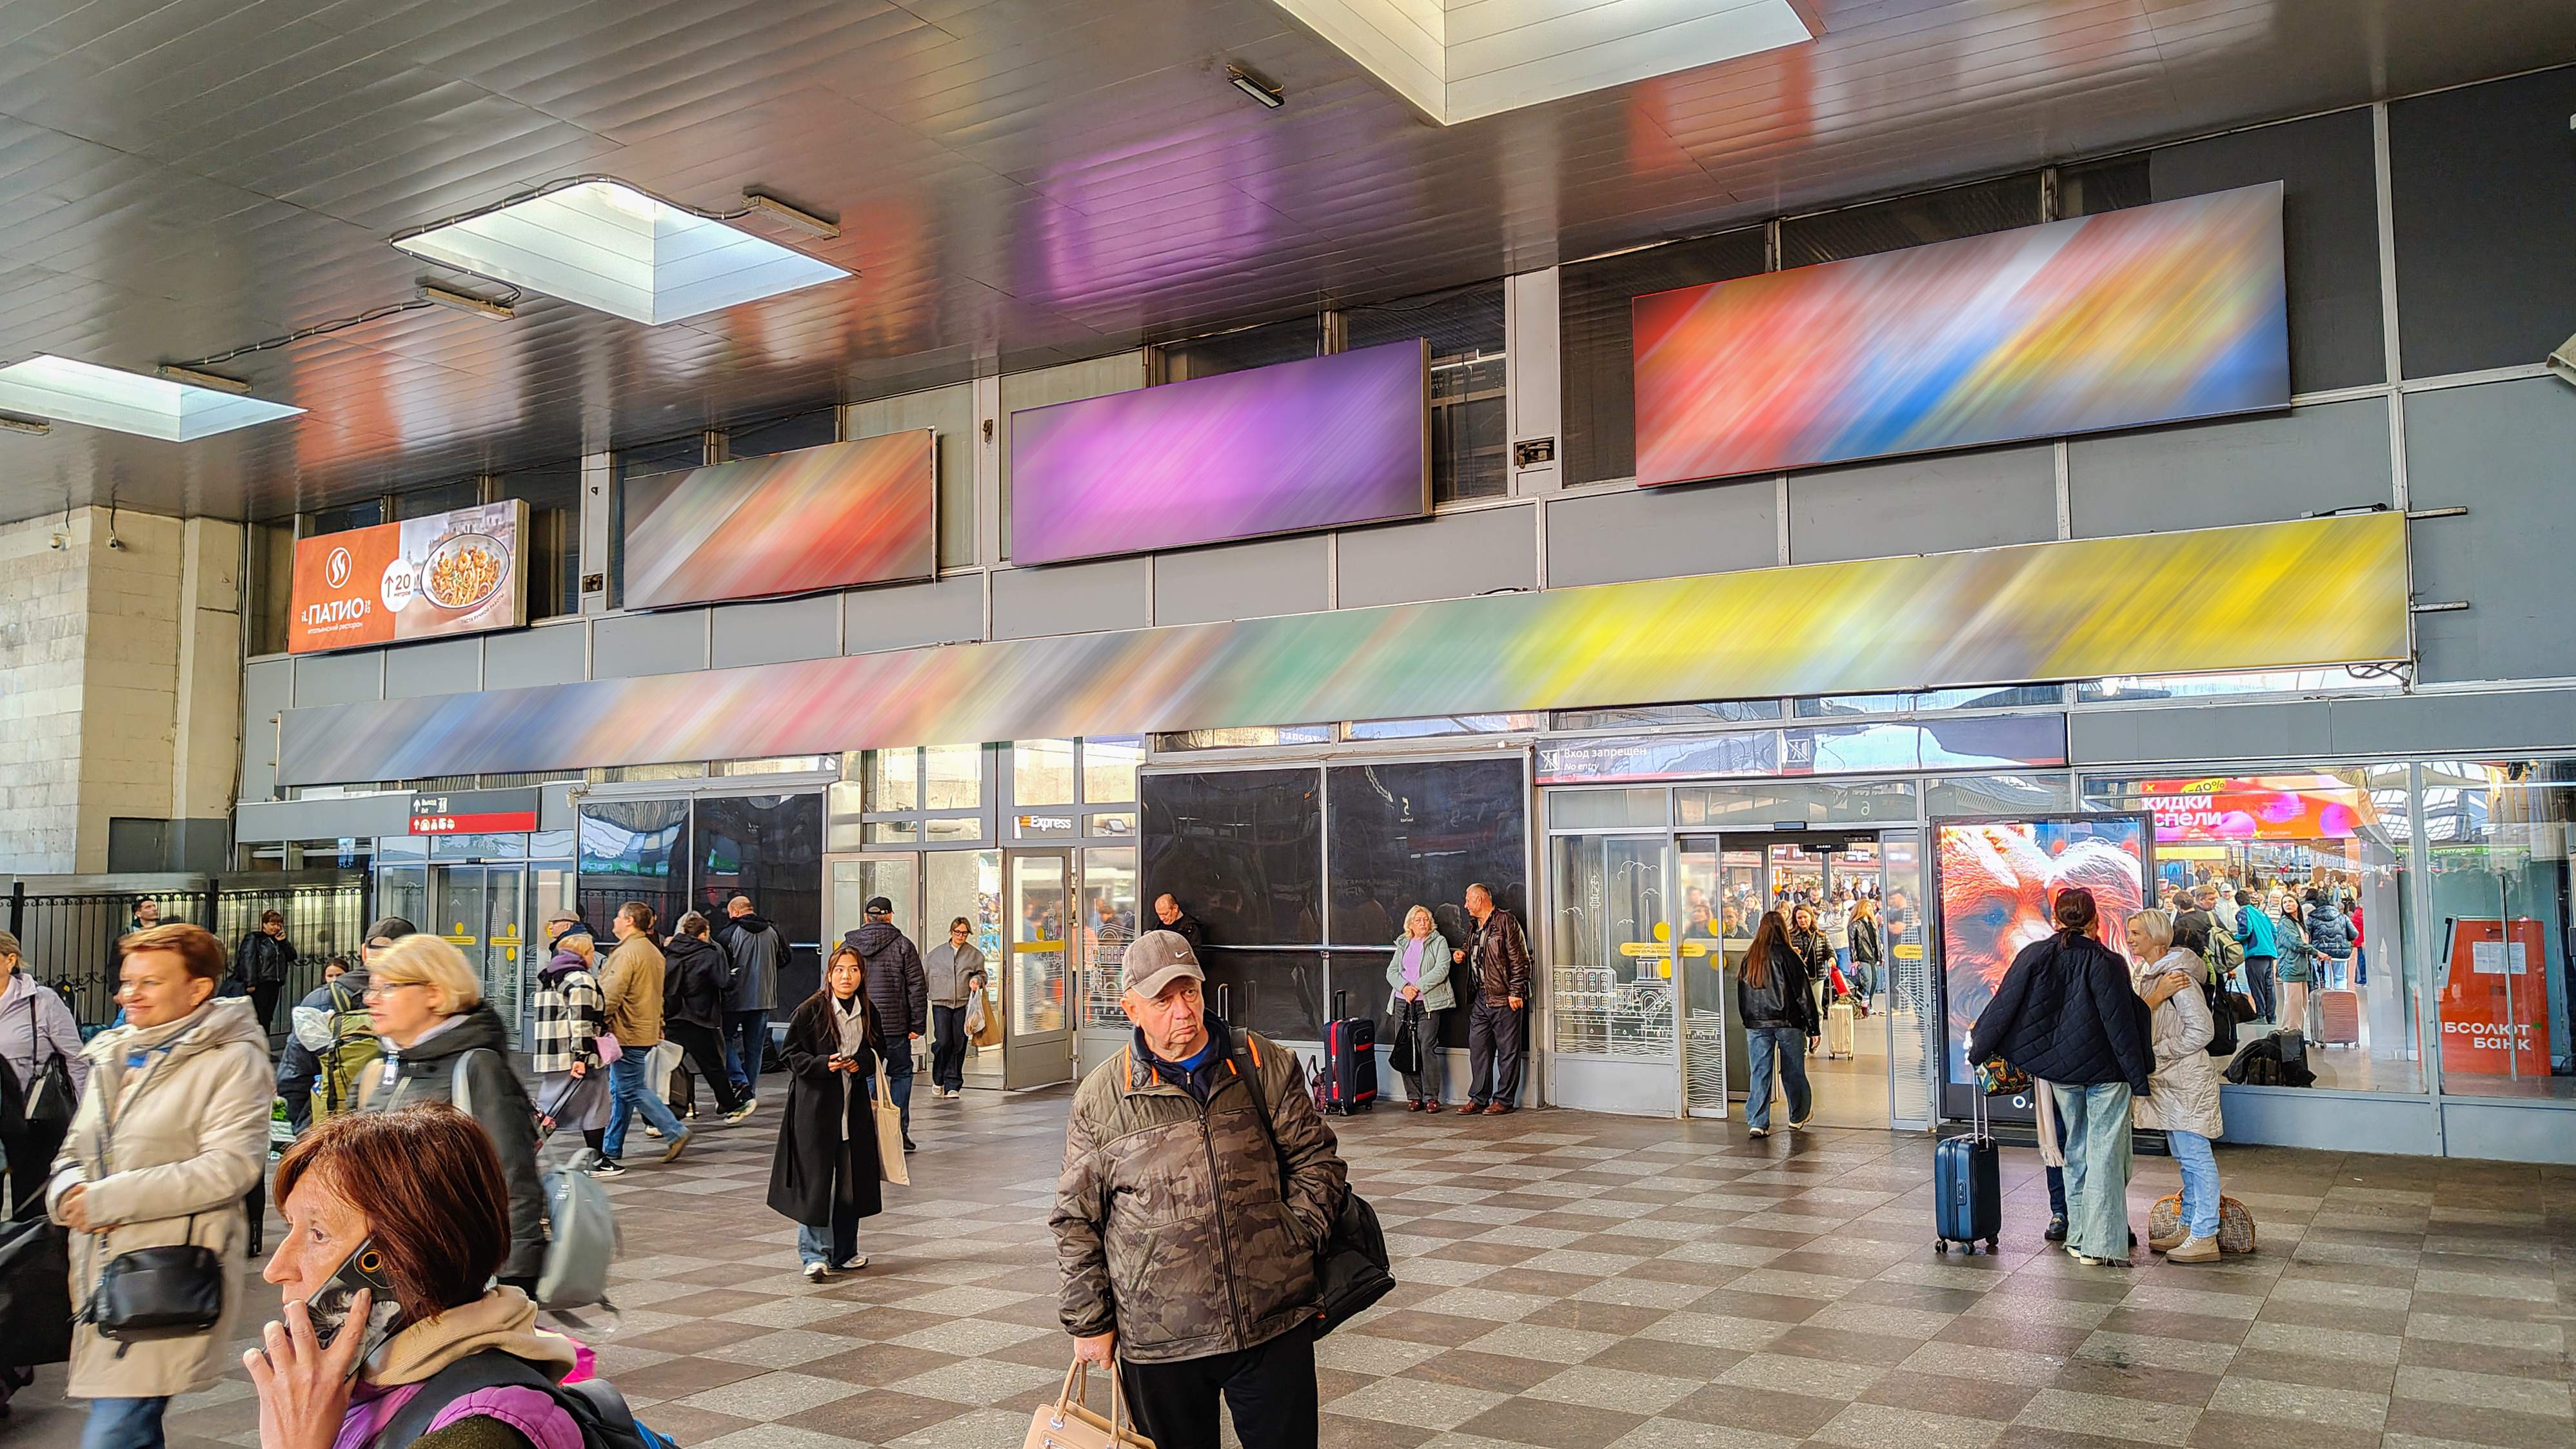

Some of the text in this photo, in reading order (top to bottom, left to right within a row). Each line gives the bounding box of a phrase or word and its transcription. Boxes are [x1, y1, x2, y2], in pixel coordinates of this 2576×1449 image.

[395, 573, 411, 591] 20
[308, 597, 364, 626] ПАТИО
[1564, 749, 1590, 759] Вход
[2142, 795, 2214, 813] кидки
[1031, 815, 1072, 832] Express
[2440, 1021, 2531, 1036] БСОЛЮТ
